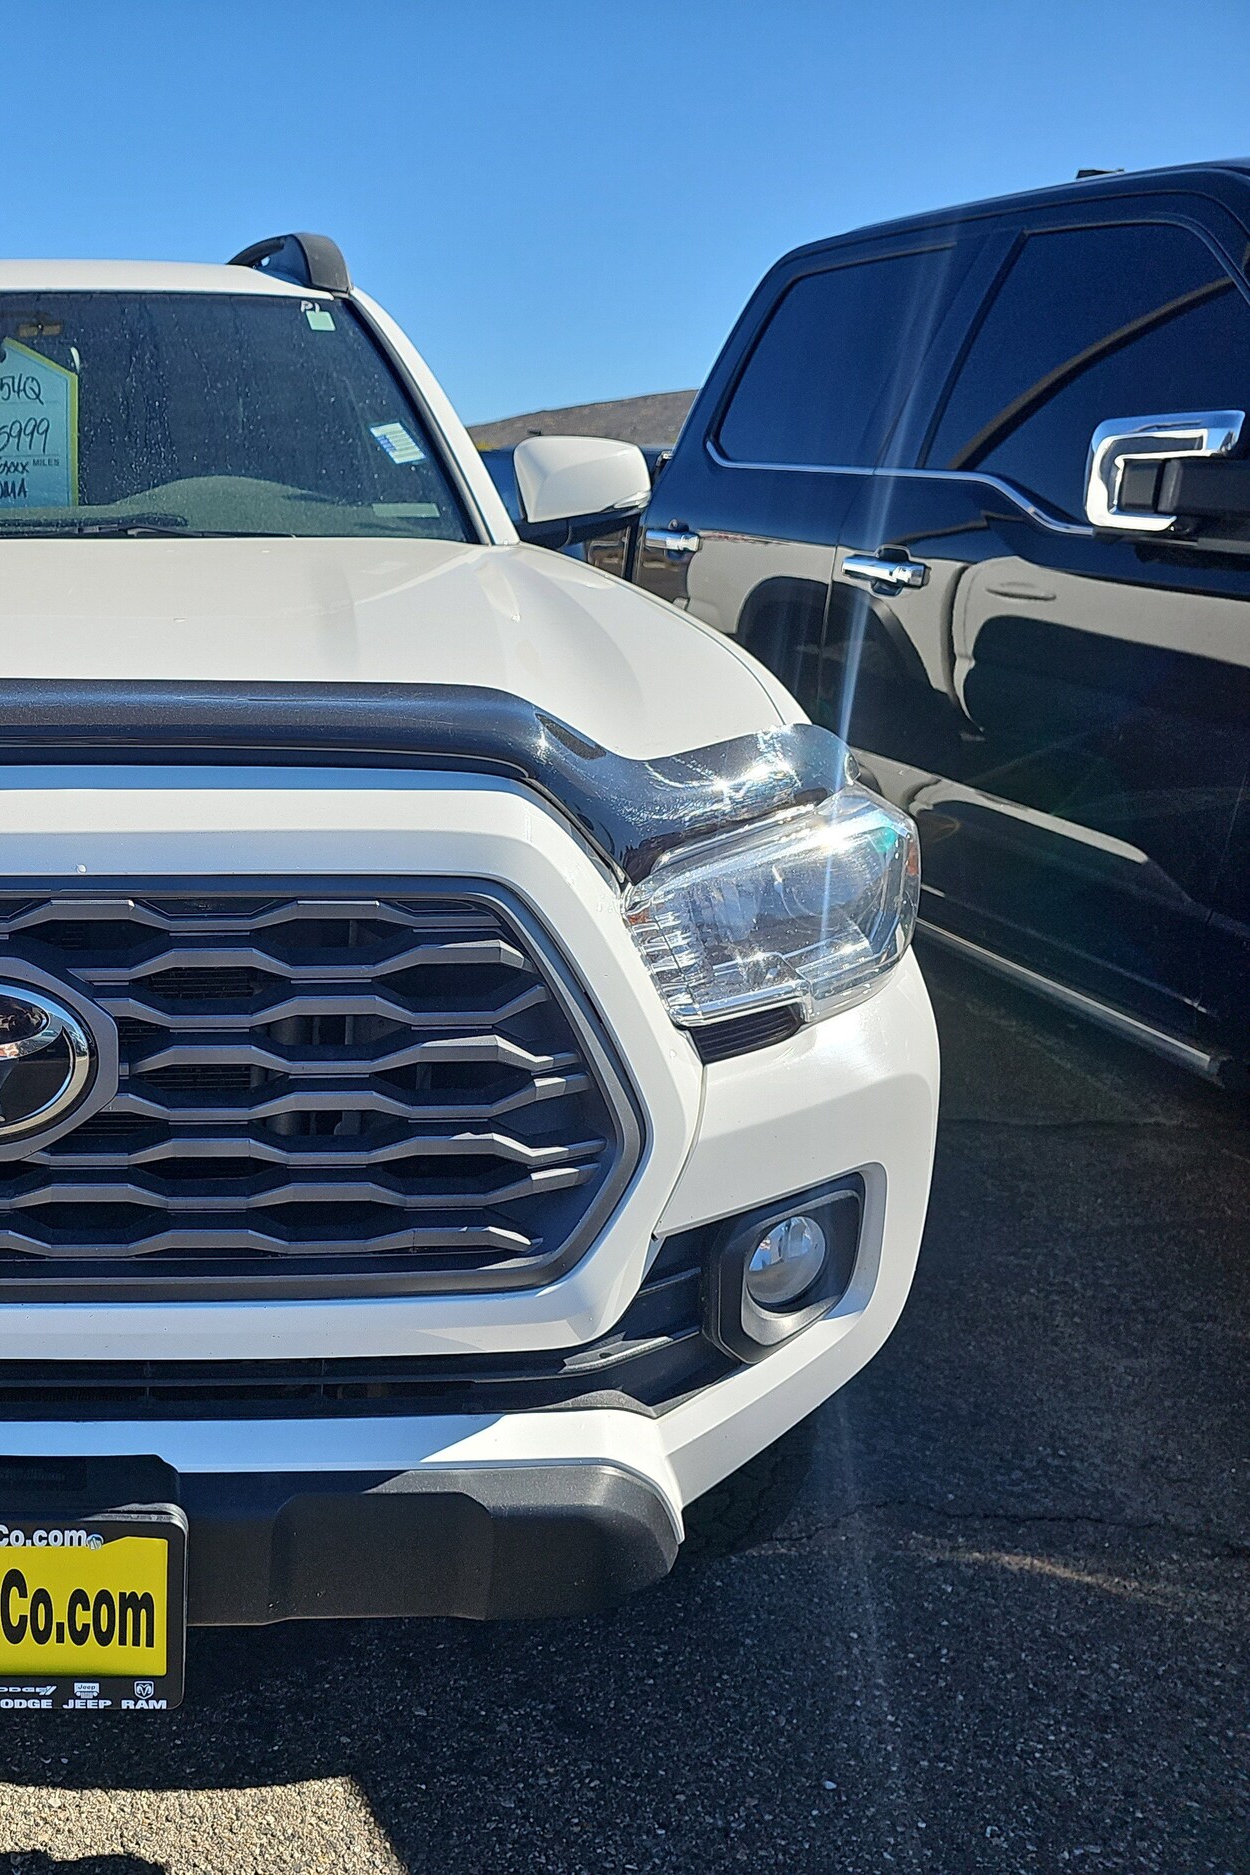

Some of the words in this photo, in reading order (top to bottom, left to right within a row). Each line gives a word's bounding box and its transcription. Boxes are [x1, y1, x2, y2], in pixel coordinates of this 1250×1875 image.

[32, 458, 59, 467] MILES
[62, 1698, 112, 1709] JEEP
[121, 1699, 167, 1709] RAM
